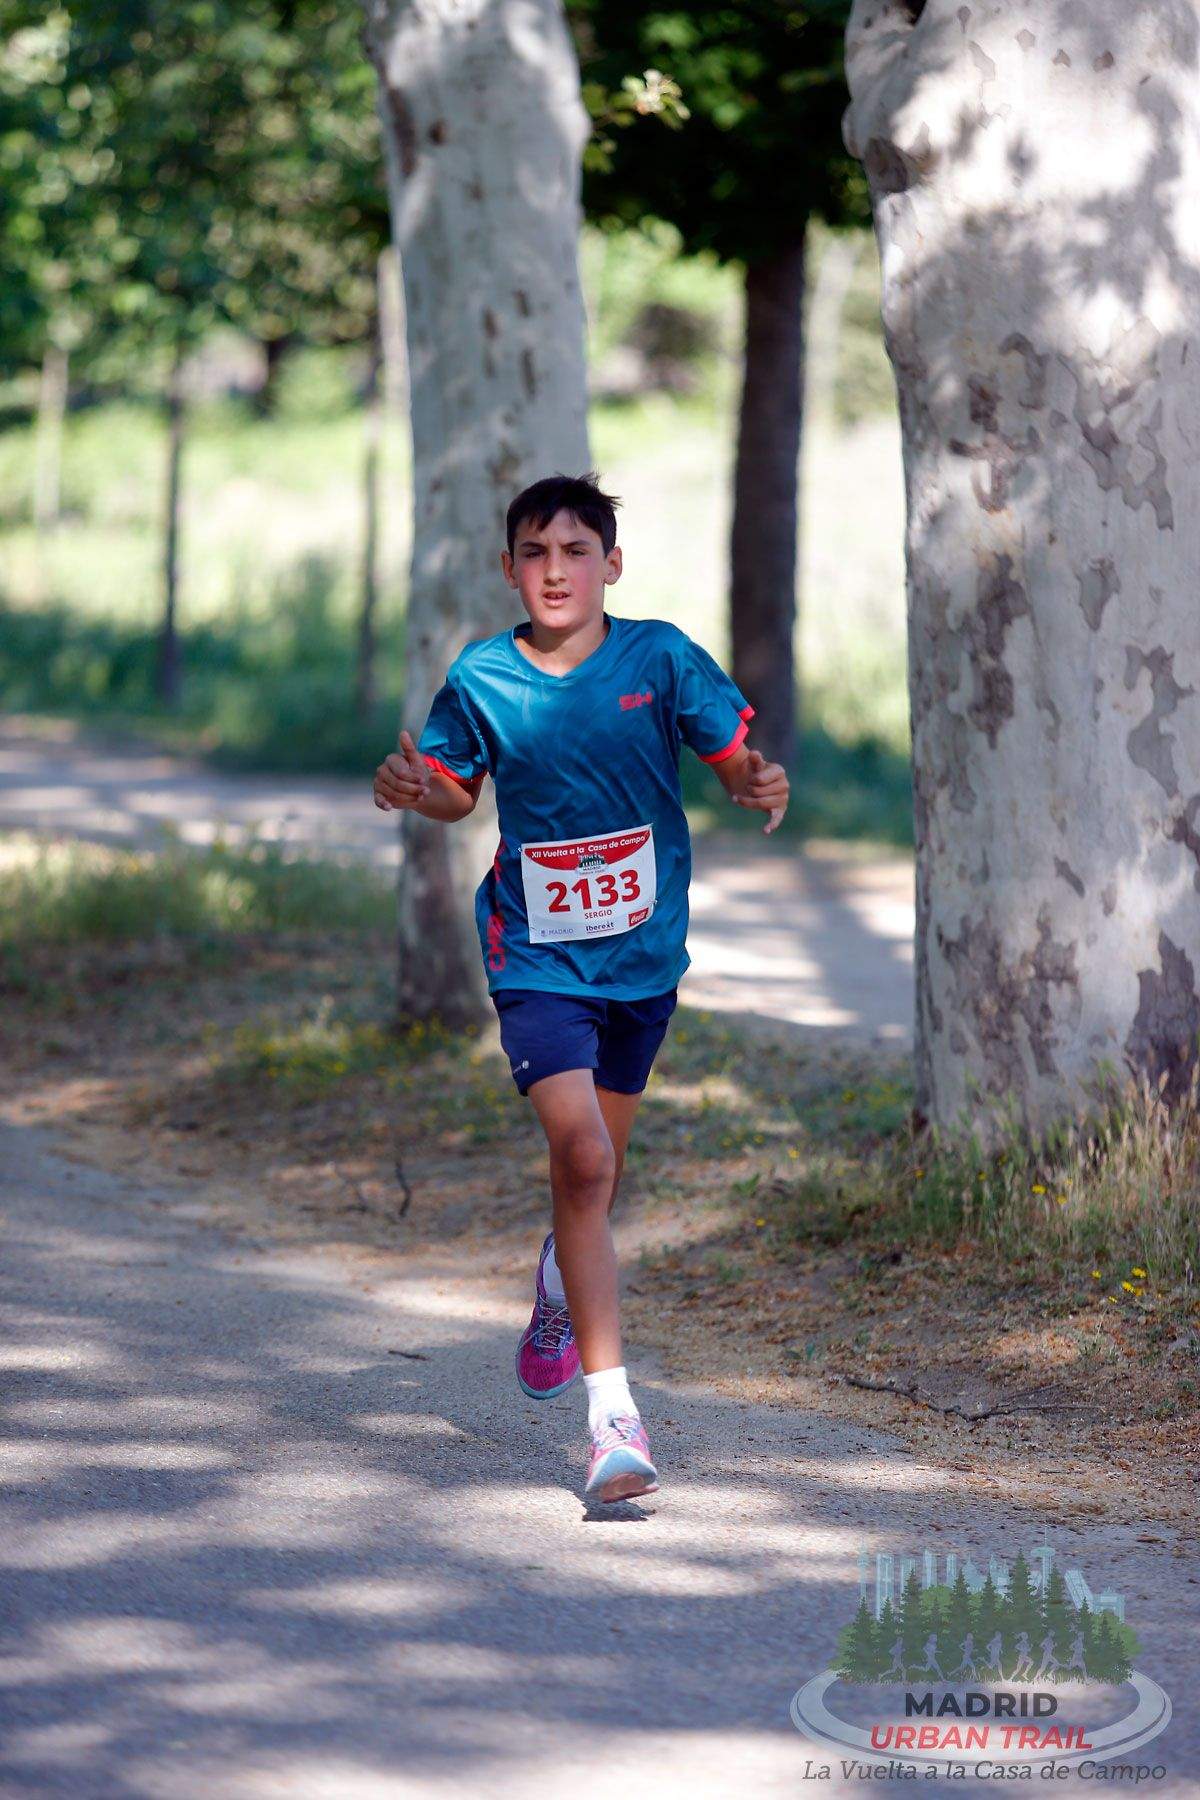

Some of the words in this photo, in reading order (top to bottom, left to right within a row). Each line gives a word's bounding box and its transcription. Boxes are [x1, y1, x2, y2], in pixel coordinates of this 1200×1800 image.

[543, 849, 568, 858] Vuelta
[576, 846, 585, 854] la
[587, 844, 608, 852] Casa
[608, 840, 619, 849] de
[620, 835, 646, 847] Campo
[545, 869, 641, 913] 2133
[584, 909, 613, 920] SERGIO
[548, 928, 574, 936] MADRID
